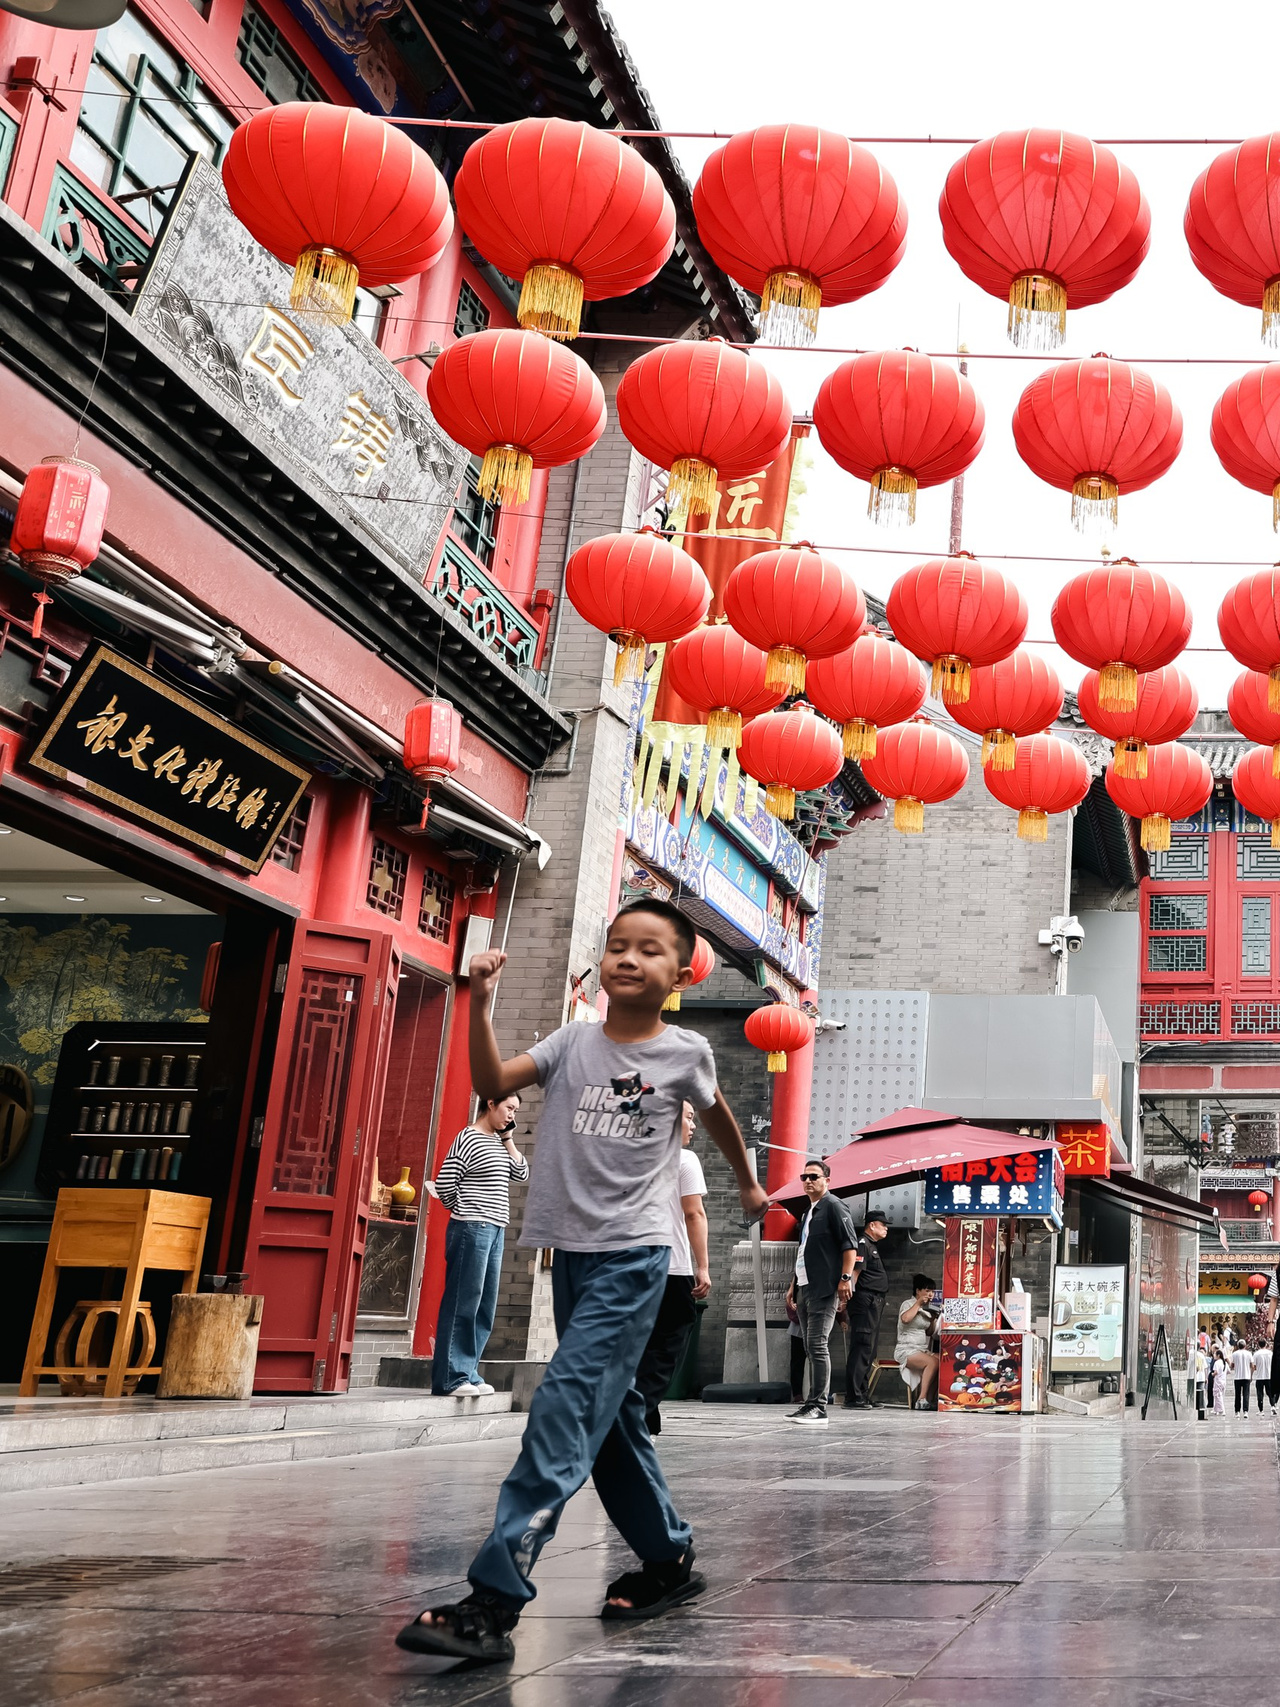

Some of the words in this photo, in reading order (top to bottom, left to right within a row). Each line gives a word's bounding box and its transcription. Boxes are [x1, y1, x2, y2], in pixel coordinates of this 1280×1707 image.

[572, 1108, 650, 1138] BLACK
[1060, 1128, 1105, 1170] 茶
[941, 1151, 1039, 1183] 相声大会
[951, 1184, 1030, 1205] 售票处
[1060, 1280, 1121, 1293] 天津大碗茶
[1076, 1340, 1086, 1356] 9
